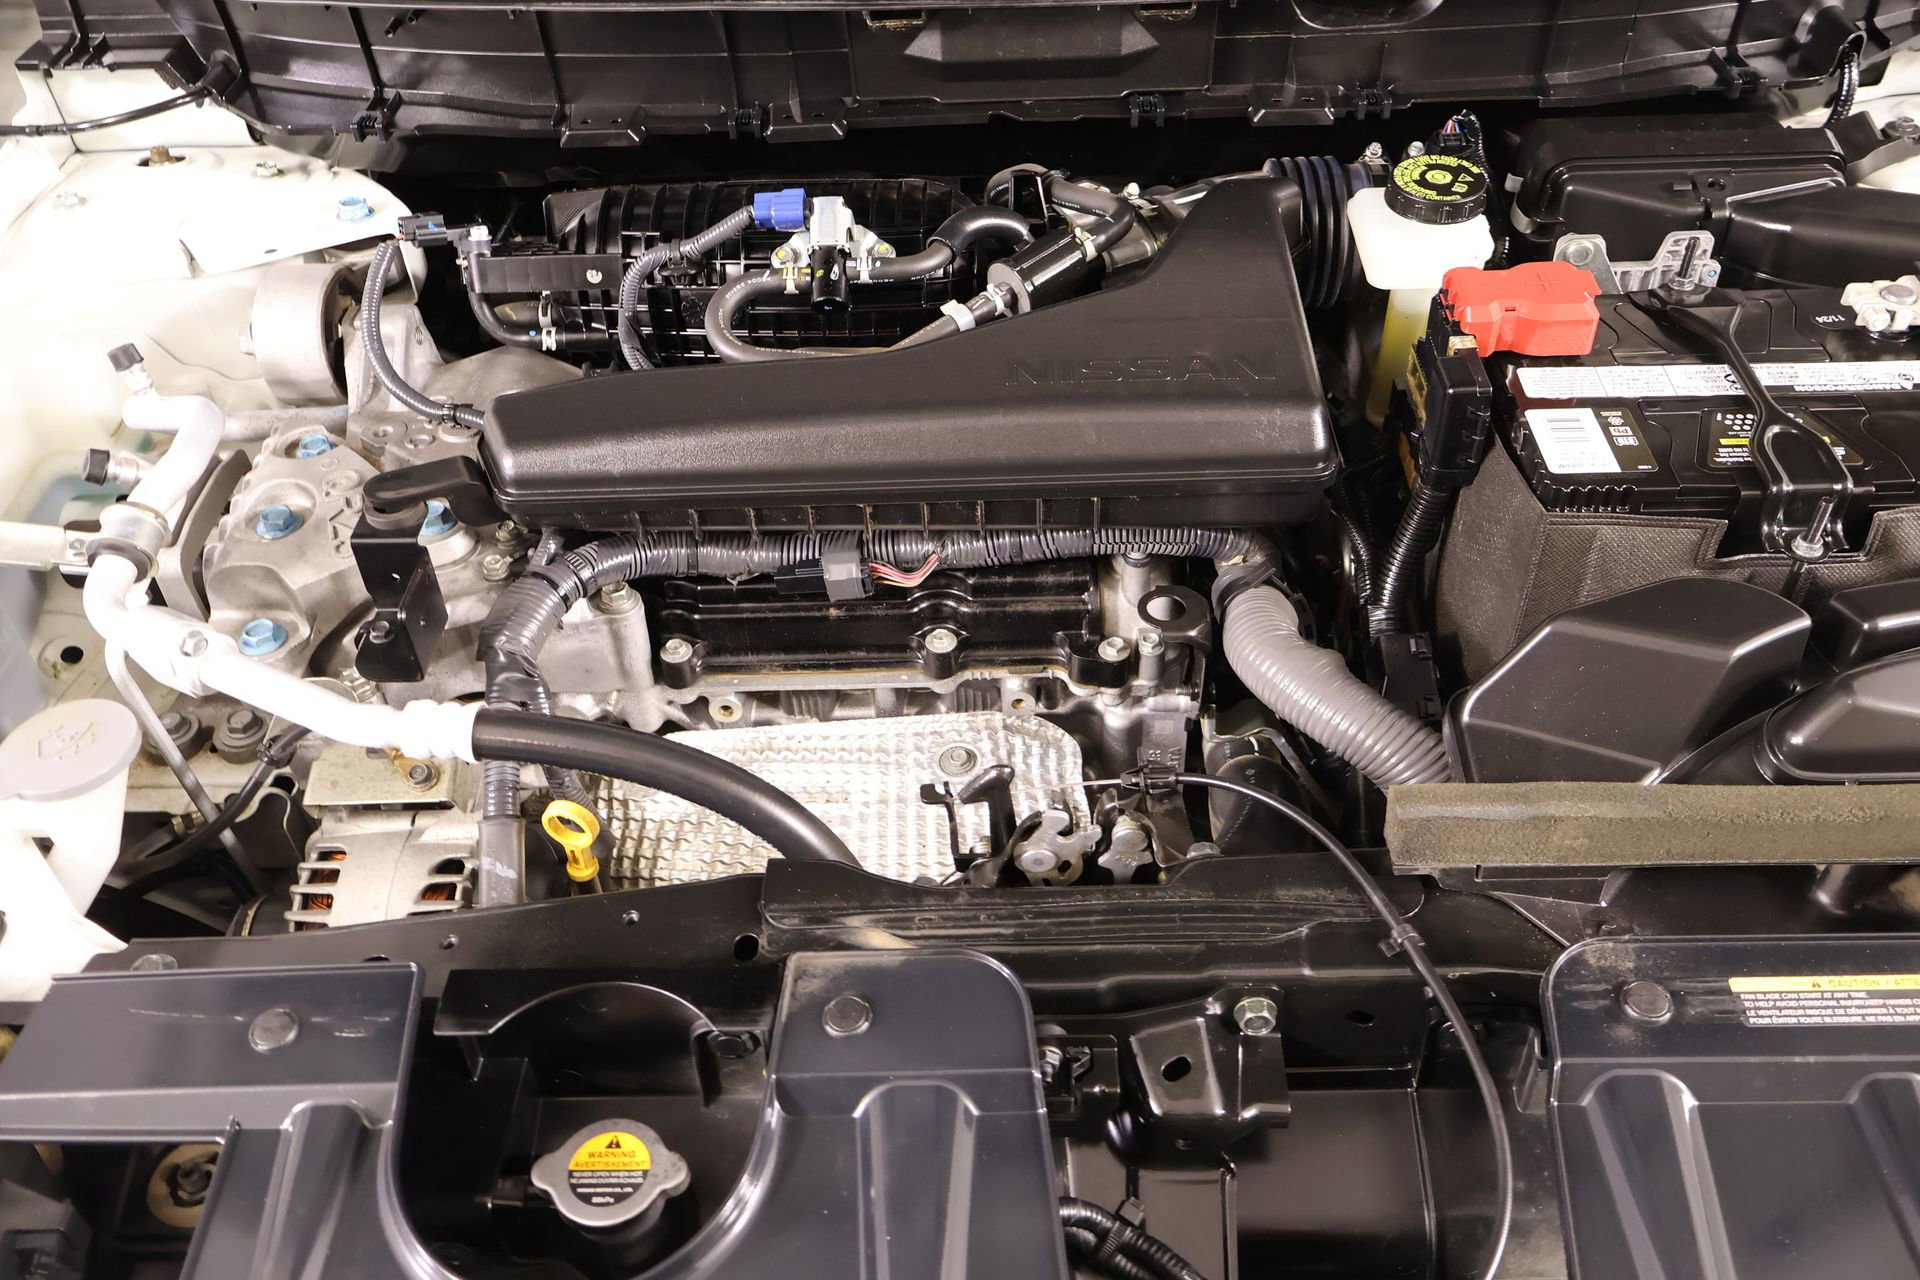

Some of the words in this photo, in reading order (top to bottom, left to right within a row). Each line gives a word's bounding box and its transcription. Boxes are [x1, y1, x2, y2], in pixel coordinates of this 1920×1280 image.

[1816, 315, 1845, 323] 11/24
[1005, 359, 1276, 386] NISSAN
[1613, 427, 1628, 435] Pb
[588, 1151, 636, 1159] WARNING
[574, 1160, 647, 1168] AVERTISSEMENT
